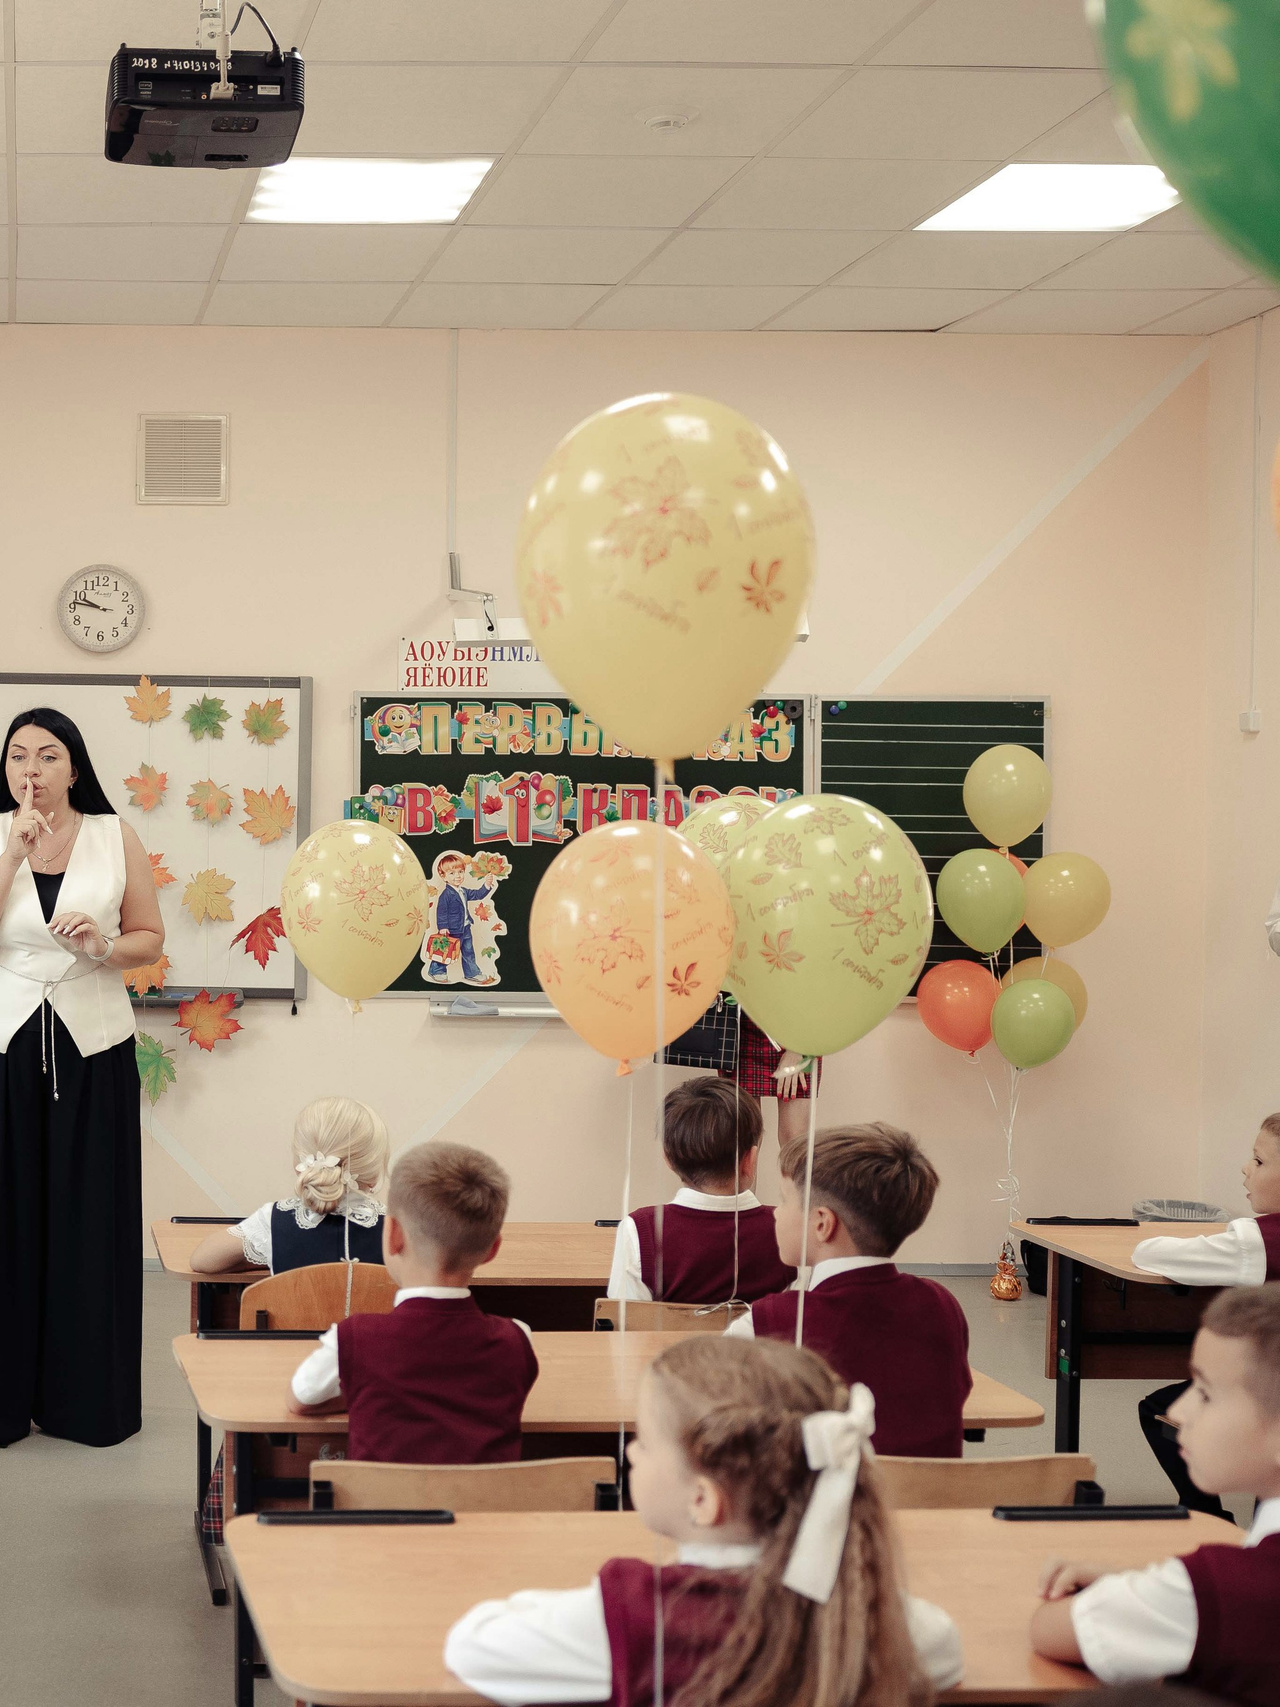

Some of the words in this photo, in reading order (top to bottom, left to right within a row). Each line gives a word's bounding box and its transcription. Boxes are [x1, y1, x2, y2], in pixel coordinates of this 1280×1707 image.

[132, 58, 157, 69] 2018
[83, 580, 96, 591] 11
[95, 576, 110, 587] 12
[113, 581, 119, 591] 1
[73, 591, 87, 602] 10
[121, 591, 129, 602] 2
[68, 602, 76, 613] 9
[126, 604, 134, 615] 3
[73, 615, 81, 625] 8
[120, 616, 129, 627] 4
[83, 626, 91, 636] 7
[96, 631, 104, 641] 6
[111, 627, 119, 637] 5
[404, 663, 489, 688] ЯЁЮИЕ
[417, 702, 648, 760] ПЕРВЫ
[692, 706, 792, 762] АЗ
[403, 782, 434, 835] В
[498, 771, 533, 846] 1
[577, 783, 778, 835] КЛА
